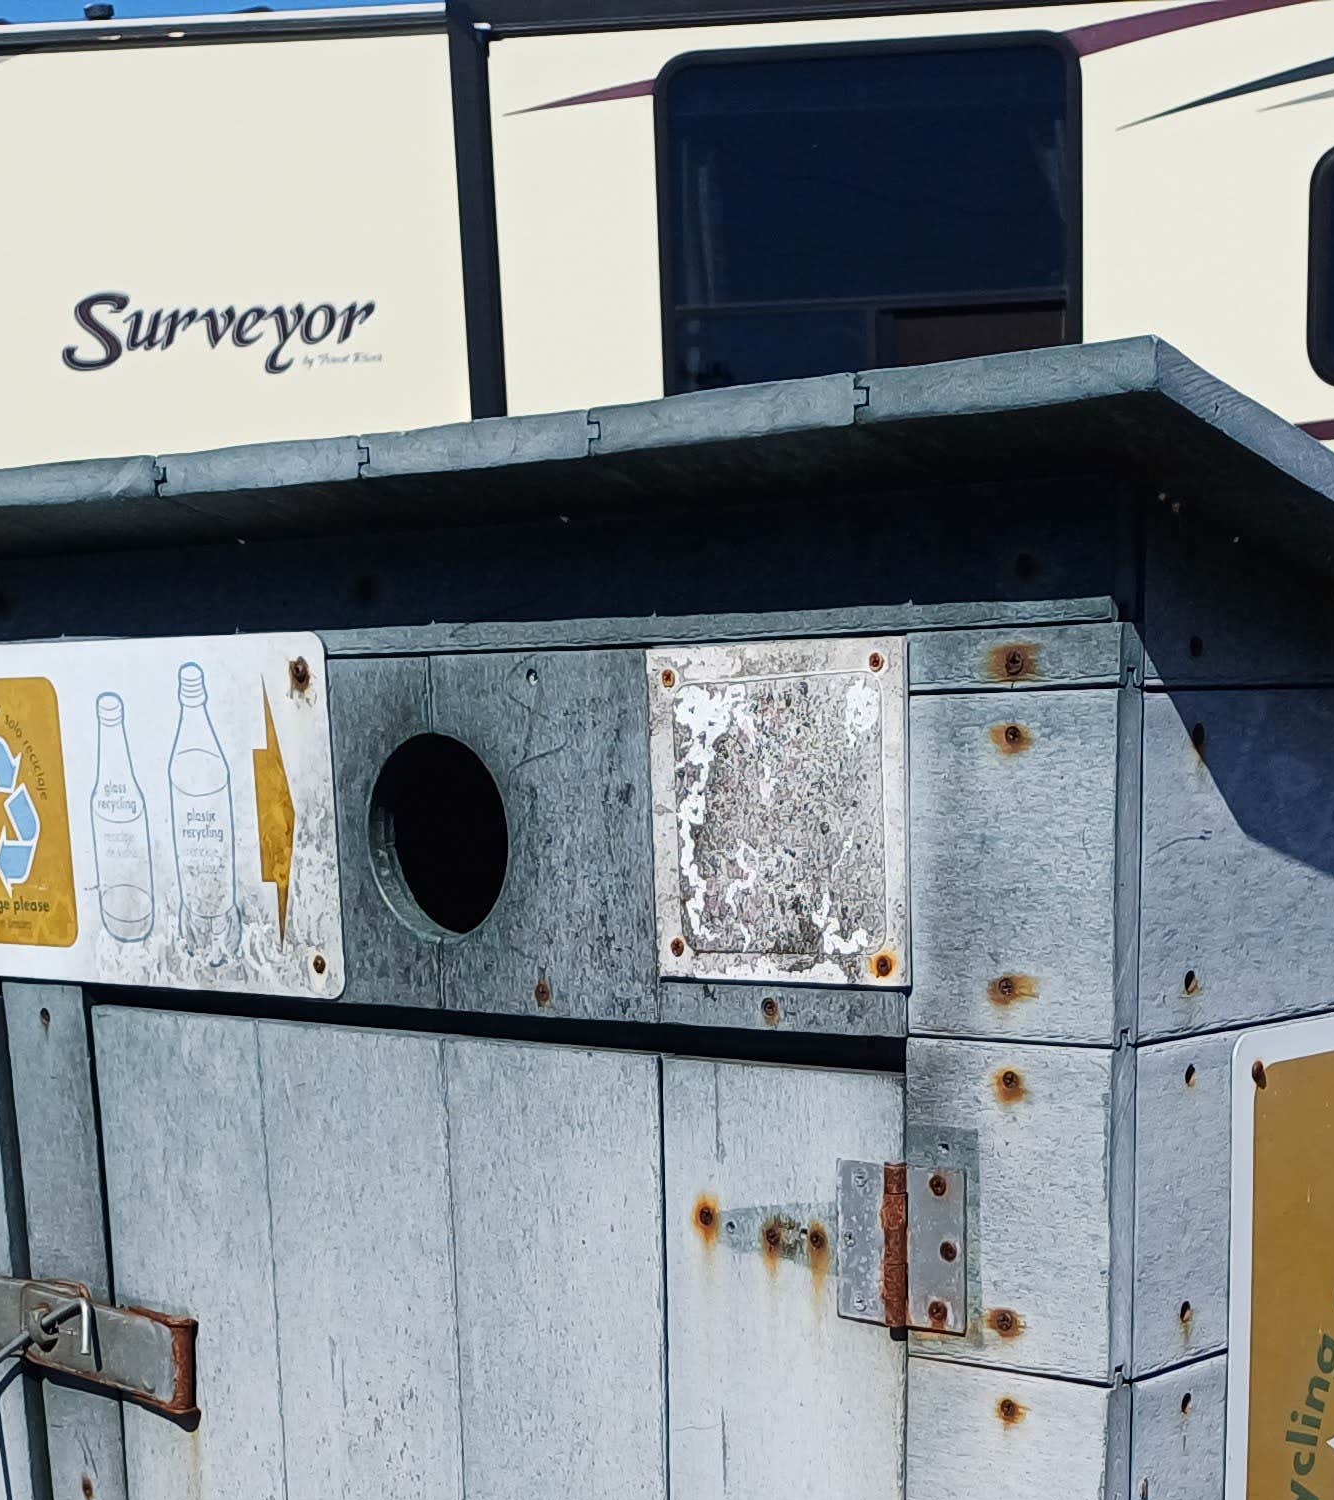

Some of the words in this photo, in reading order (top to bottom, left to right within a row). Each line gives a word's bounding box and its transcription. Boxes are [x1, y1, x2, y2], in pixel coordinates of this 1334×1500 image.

[62, 292, 376, 374] Surveyor
[5, 714, 22, 739] solo
[23, 740, 48, 800] reciclaje
[104, 780, 127, 797] glass
[97, 797, 137, 815] recycling
[186, 808, 216, 823] plastic
[182, 824, 224, 842] recycling
[13, 896, 49, 915] please
